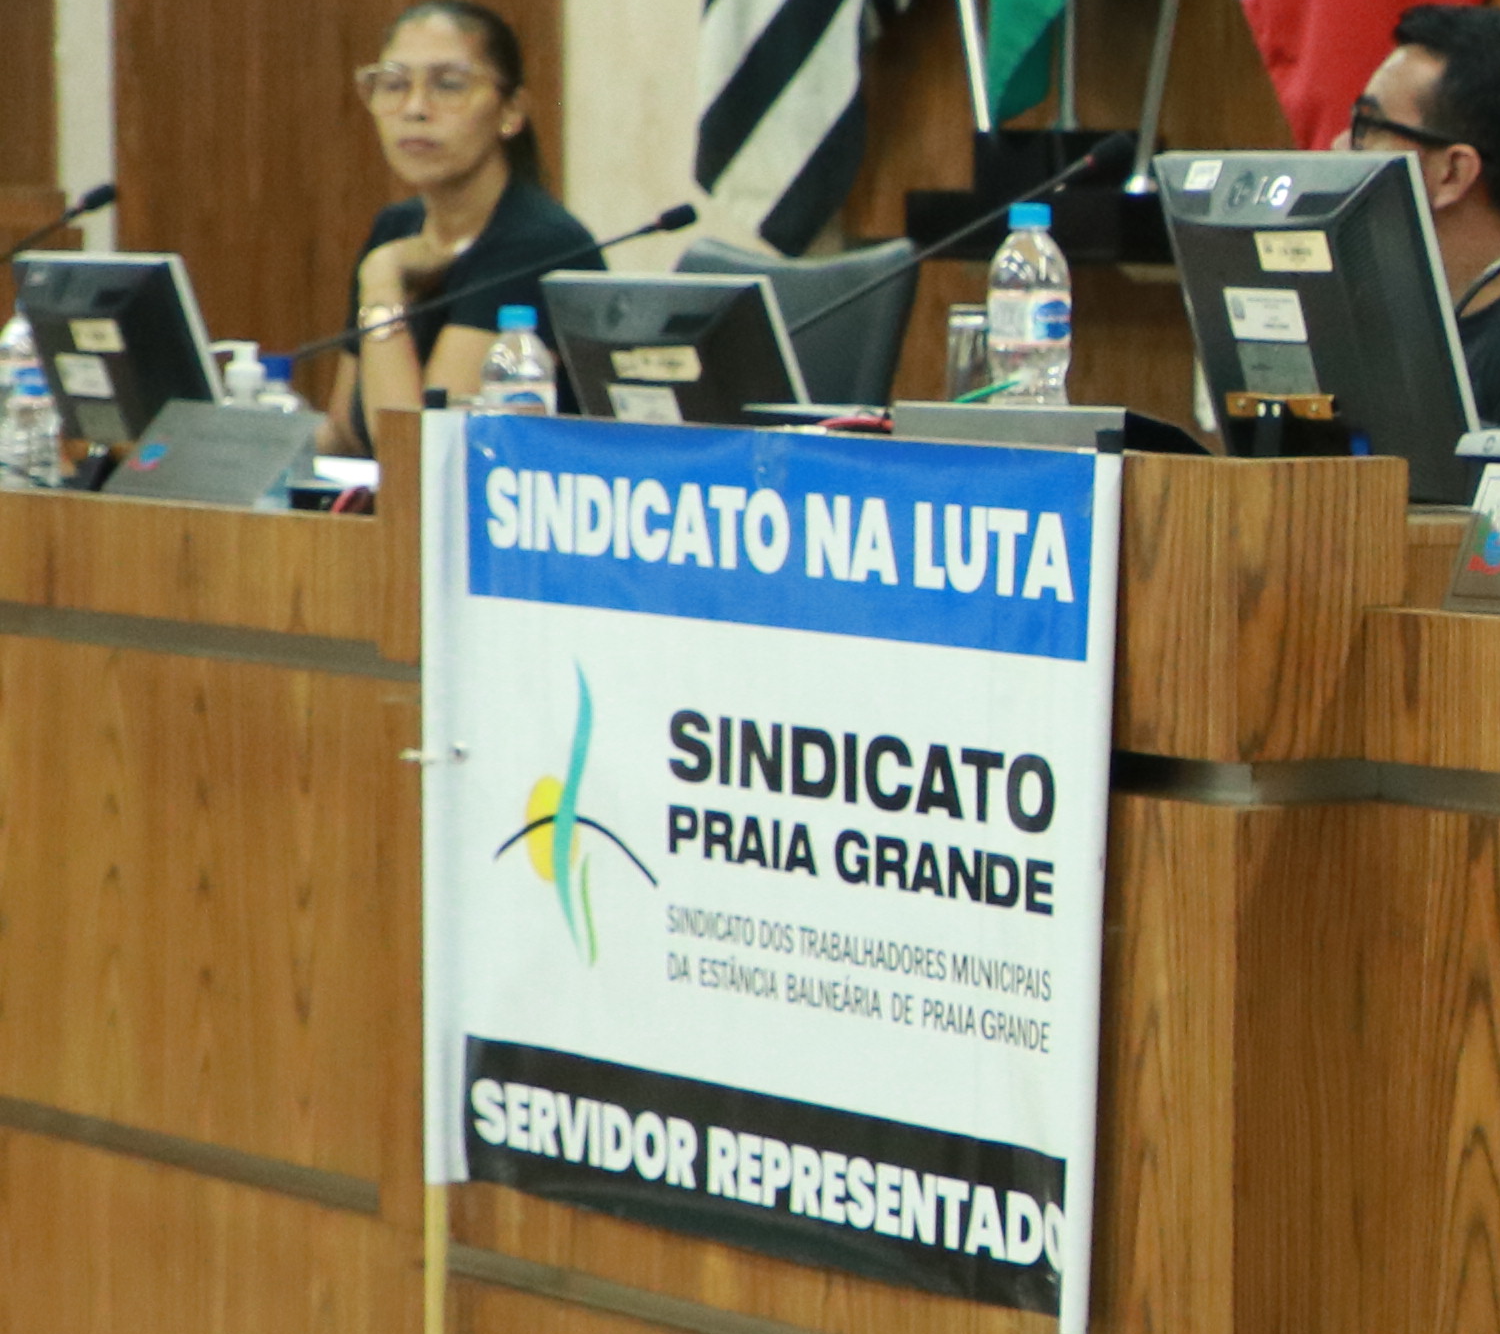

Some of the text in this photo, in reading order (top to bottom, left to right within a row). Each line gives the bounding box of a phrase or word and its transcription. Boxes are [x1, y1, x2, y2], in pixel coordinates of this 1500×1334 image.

[485, 467, 1075, 604] SINDICATO NA LUTA
[668, 709, 1056, 833] SINDICATO
[667, 804, 1054, 916] PRAIA GRANDE
[666, 904, 1053, 1002] SINDICATO DOS TRABALHADORES MUNICIPAIS
[667, 952, 1051, 1055] DA ESTÂNCIA BALNEÁRIA DE PRAIA GRANDE
[470, 1078, 696, 1190] SERVIDOR
